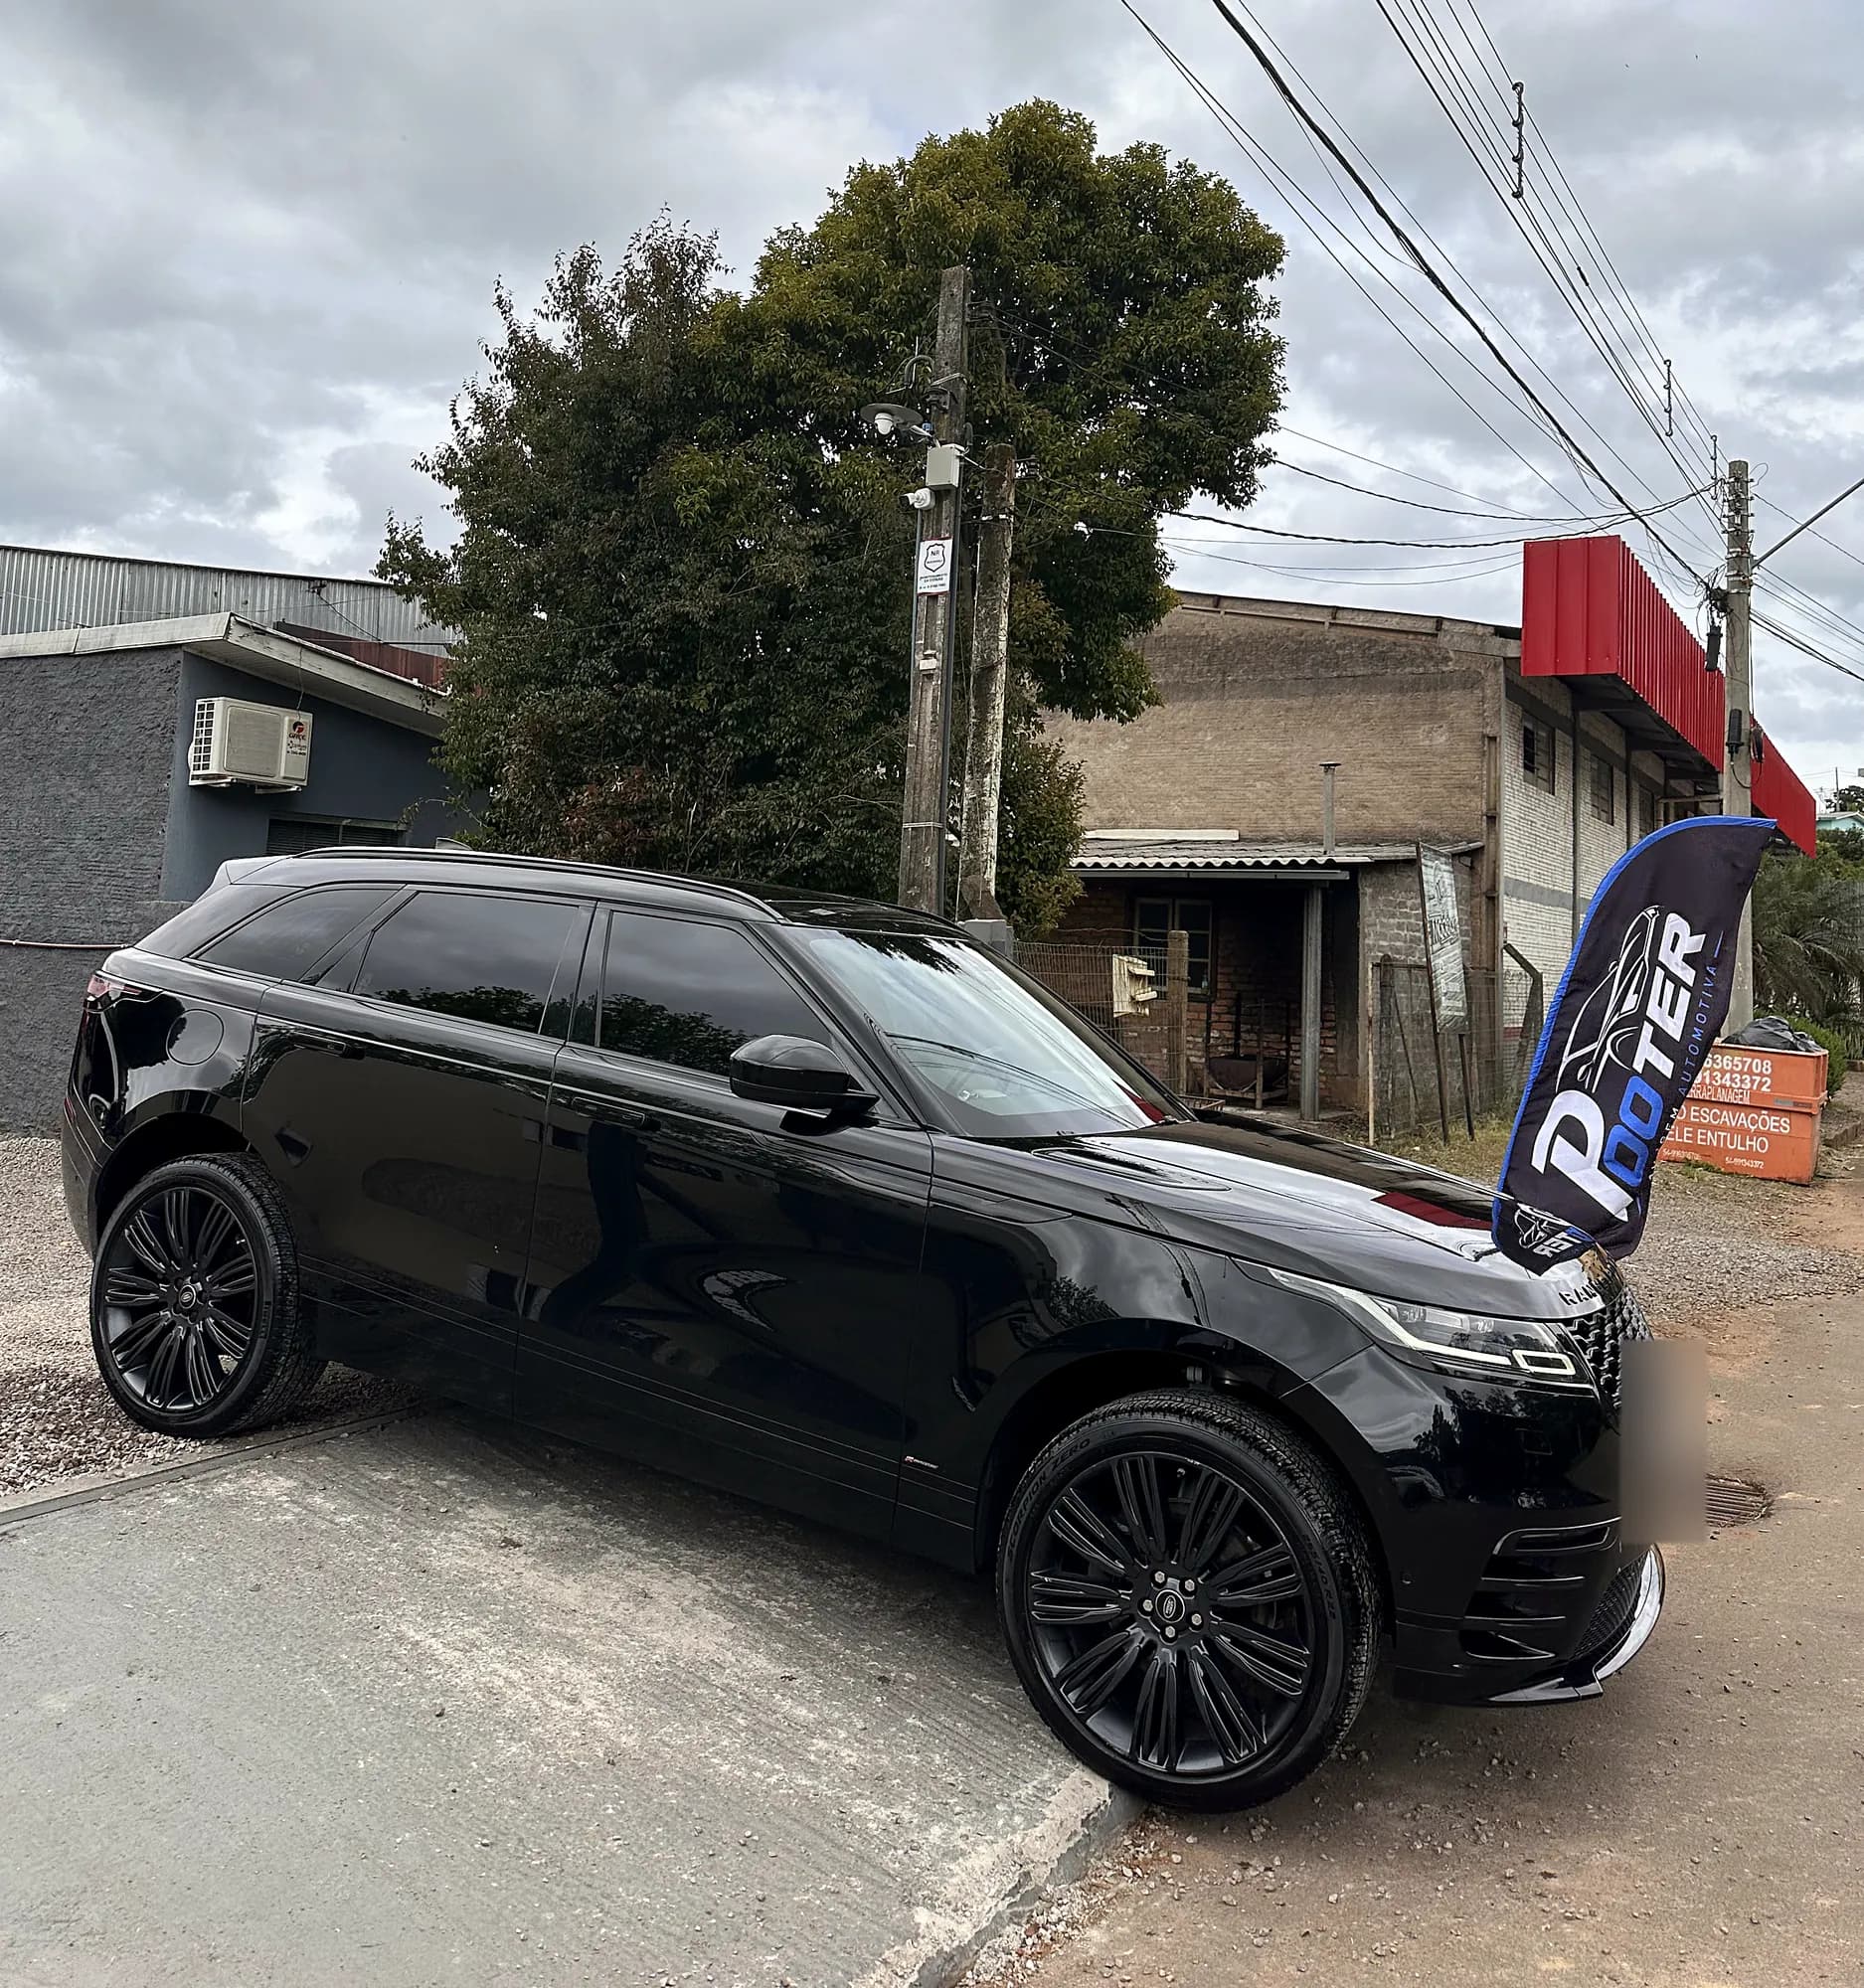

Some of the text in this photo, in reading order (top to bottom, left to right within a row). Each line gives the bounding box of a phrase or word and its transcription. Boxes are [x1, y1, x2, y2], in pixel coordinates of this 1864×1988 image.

[1678, 964, 1717, 1096] AUTOMOTIVA
[1690, 1106, 1790, 1133] ESCAVAÇÕES
[1697, 1128, 1769, 1154] ENTULHO
